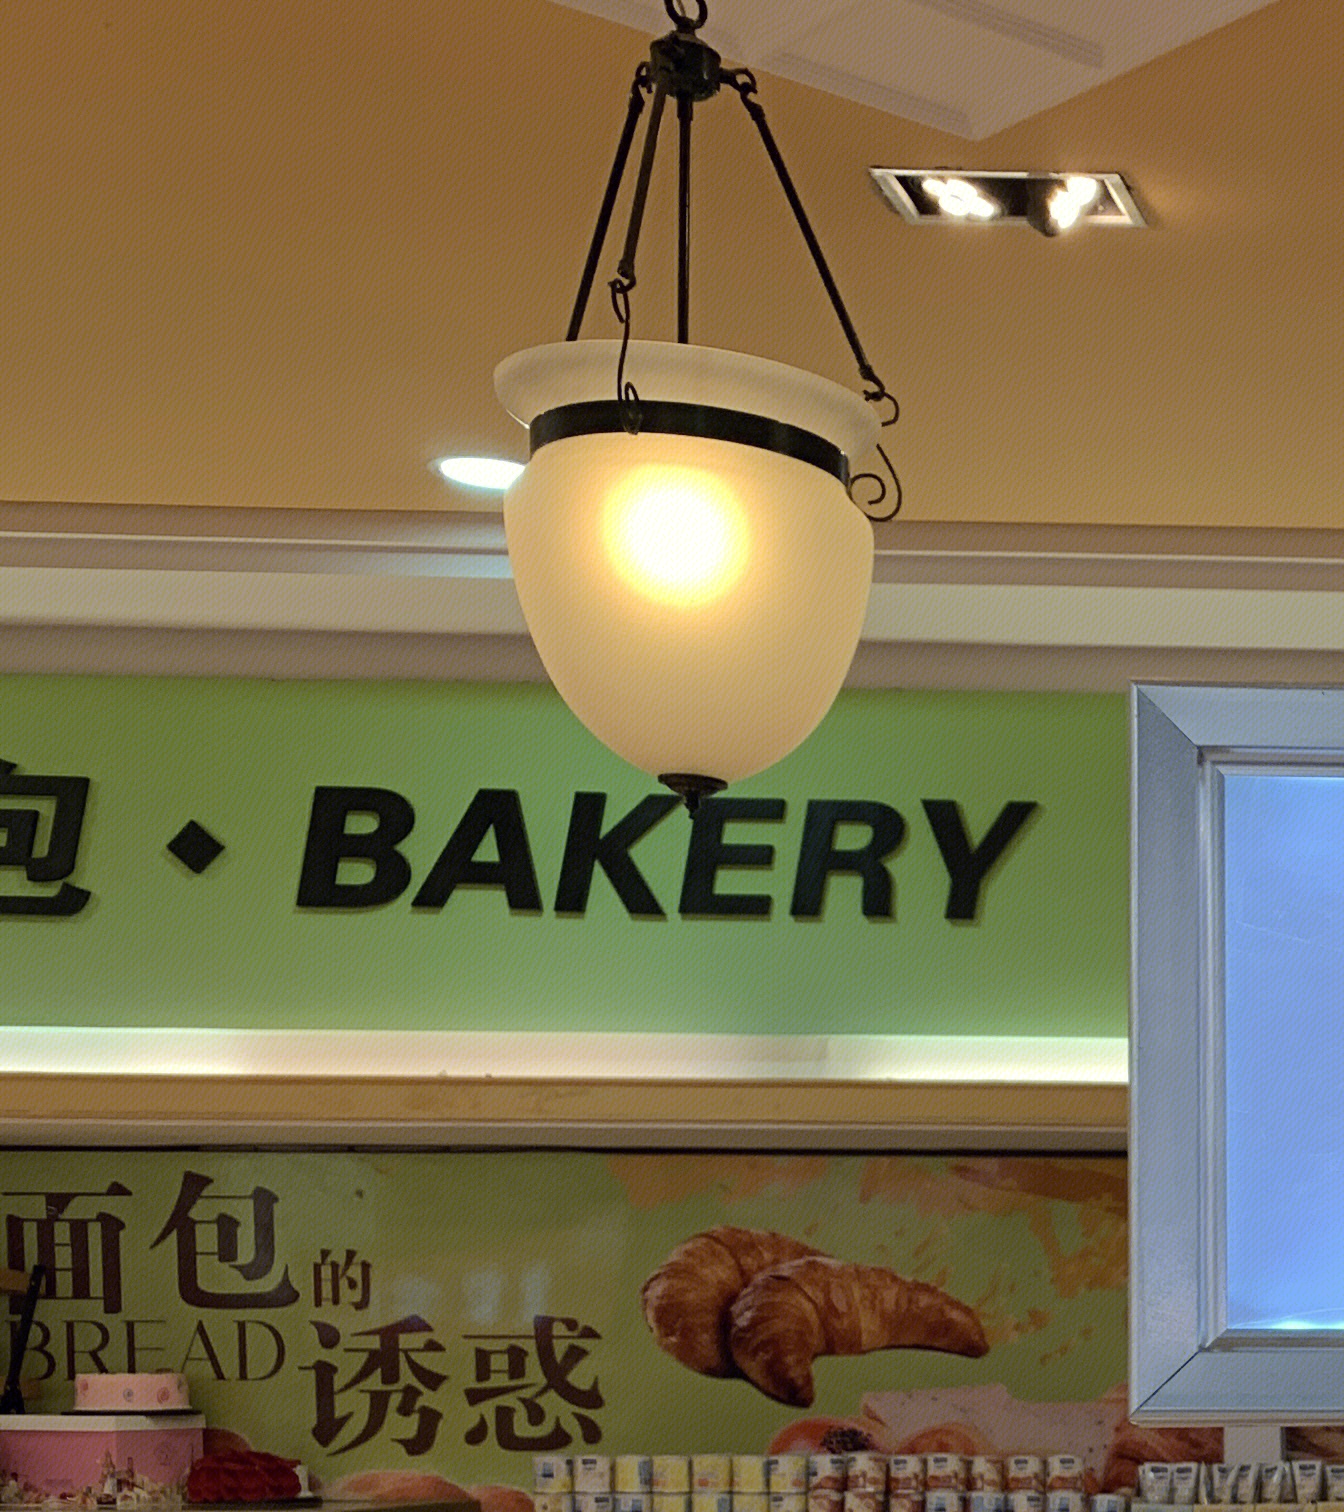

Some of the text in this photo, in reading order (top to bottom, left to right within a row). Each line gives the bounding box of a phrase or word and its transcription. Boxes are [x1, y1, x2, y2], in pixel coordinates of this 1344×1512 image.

[296, 785, 1040, 921] BAKERY
[5, 1319, 287, 1382] BREAD
[297, 1317, 605, 1457] 诱惑
